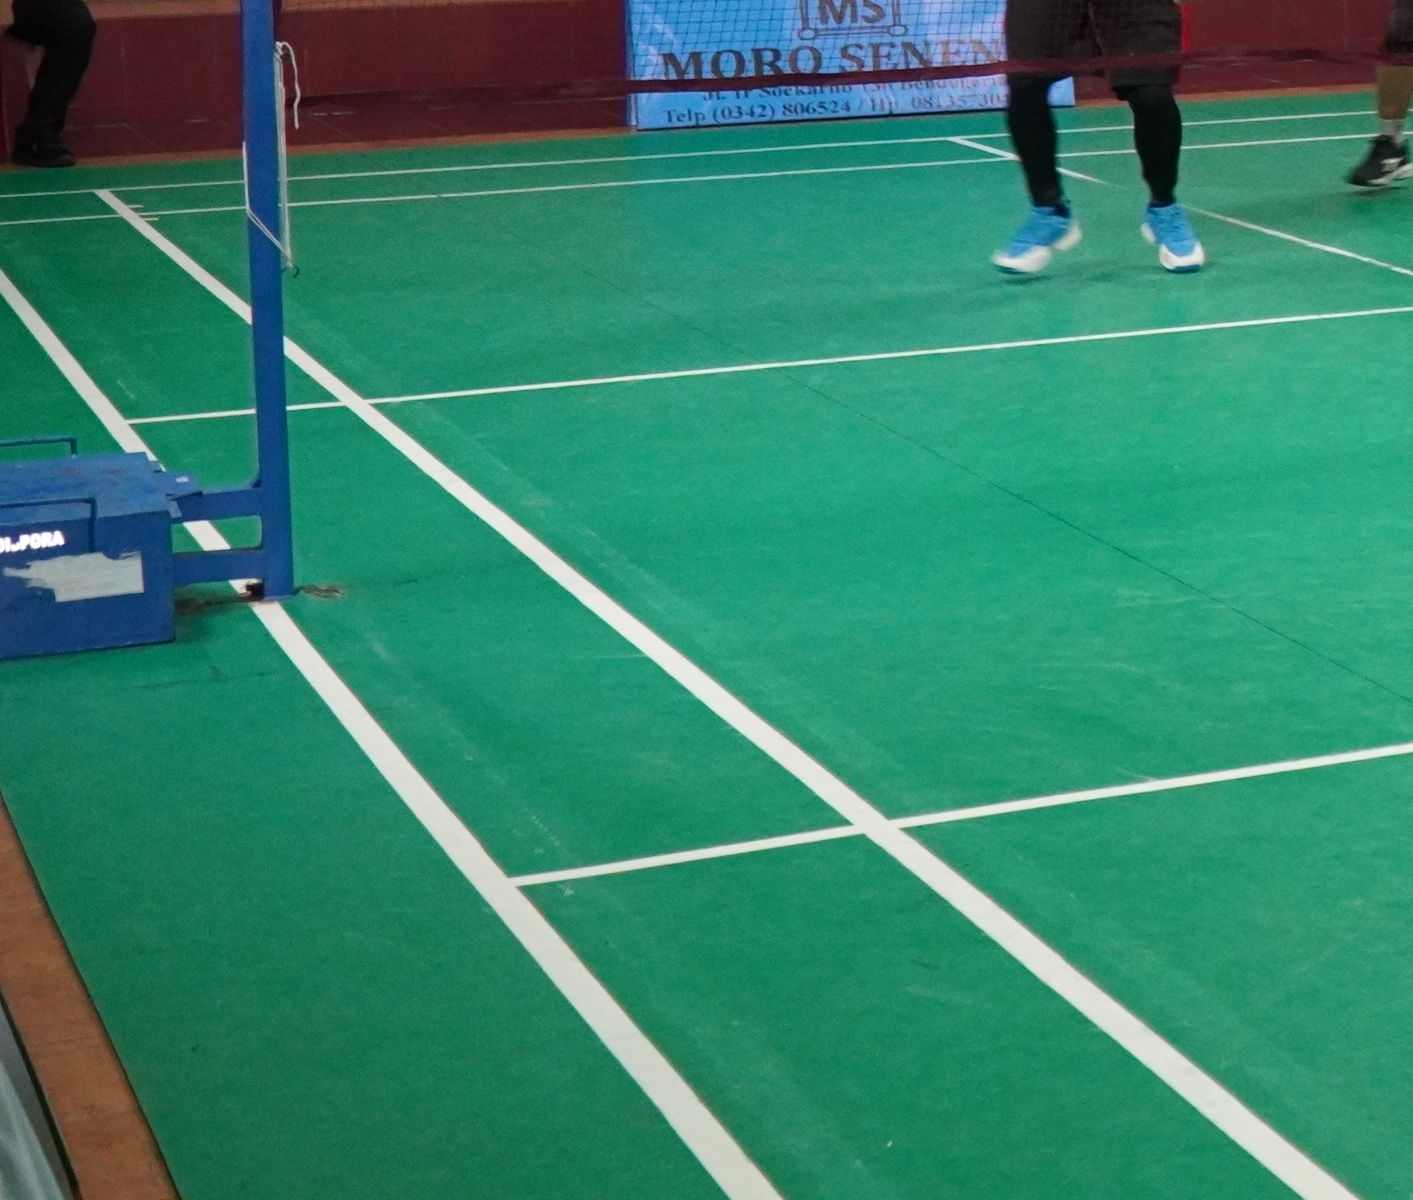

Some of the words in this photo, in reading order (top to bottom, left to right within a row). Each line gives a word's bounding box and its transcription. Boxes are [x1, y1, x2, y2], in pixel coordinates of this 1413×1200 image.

[660, 45, 823, 80] MORO
[839, 38, 1003, 71] SENEN
[666, 108, 706, 125] Telp
[713, 102, 775, 124] (0342)
[782, 99, 850, 117] 806524
